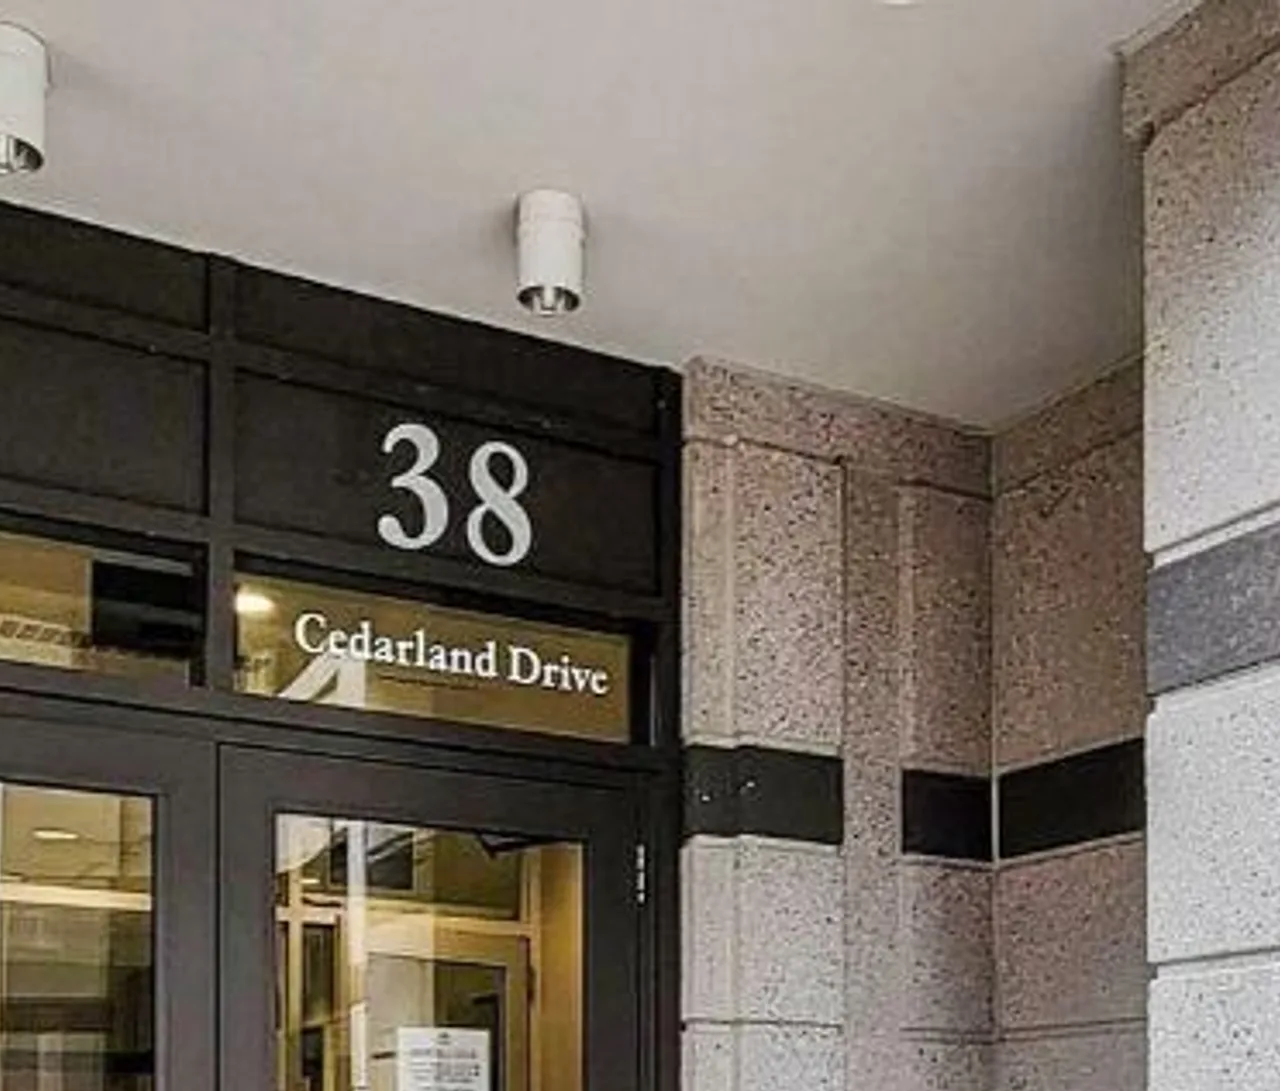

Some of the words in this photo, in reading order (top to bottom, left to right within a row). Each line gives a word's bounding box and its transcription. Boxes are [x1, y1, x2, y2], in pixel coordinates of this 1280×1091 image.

[377, 422, 532, 567] 38
[294, 612, 497, 679] Cedarland
[507, 643, 609, 695] Drive
